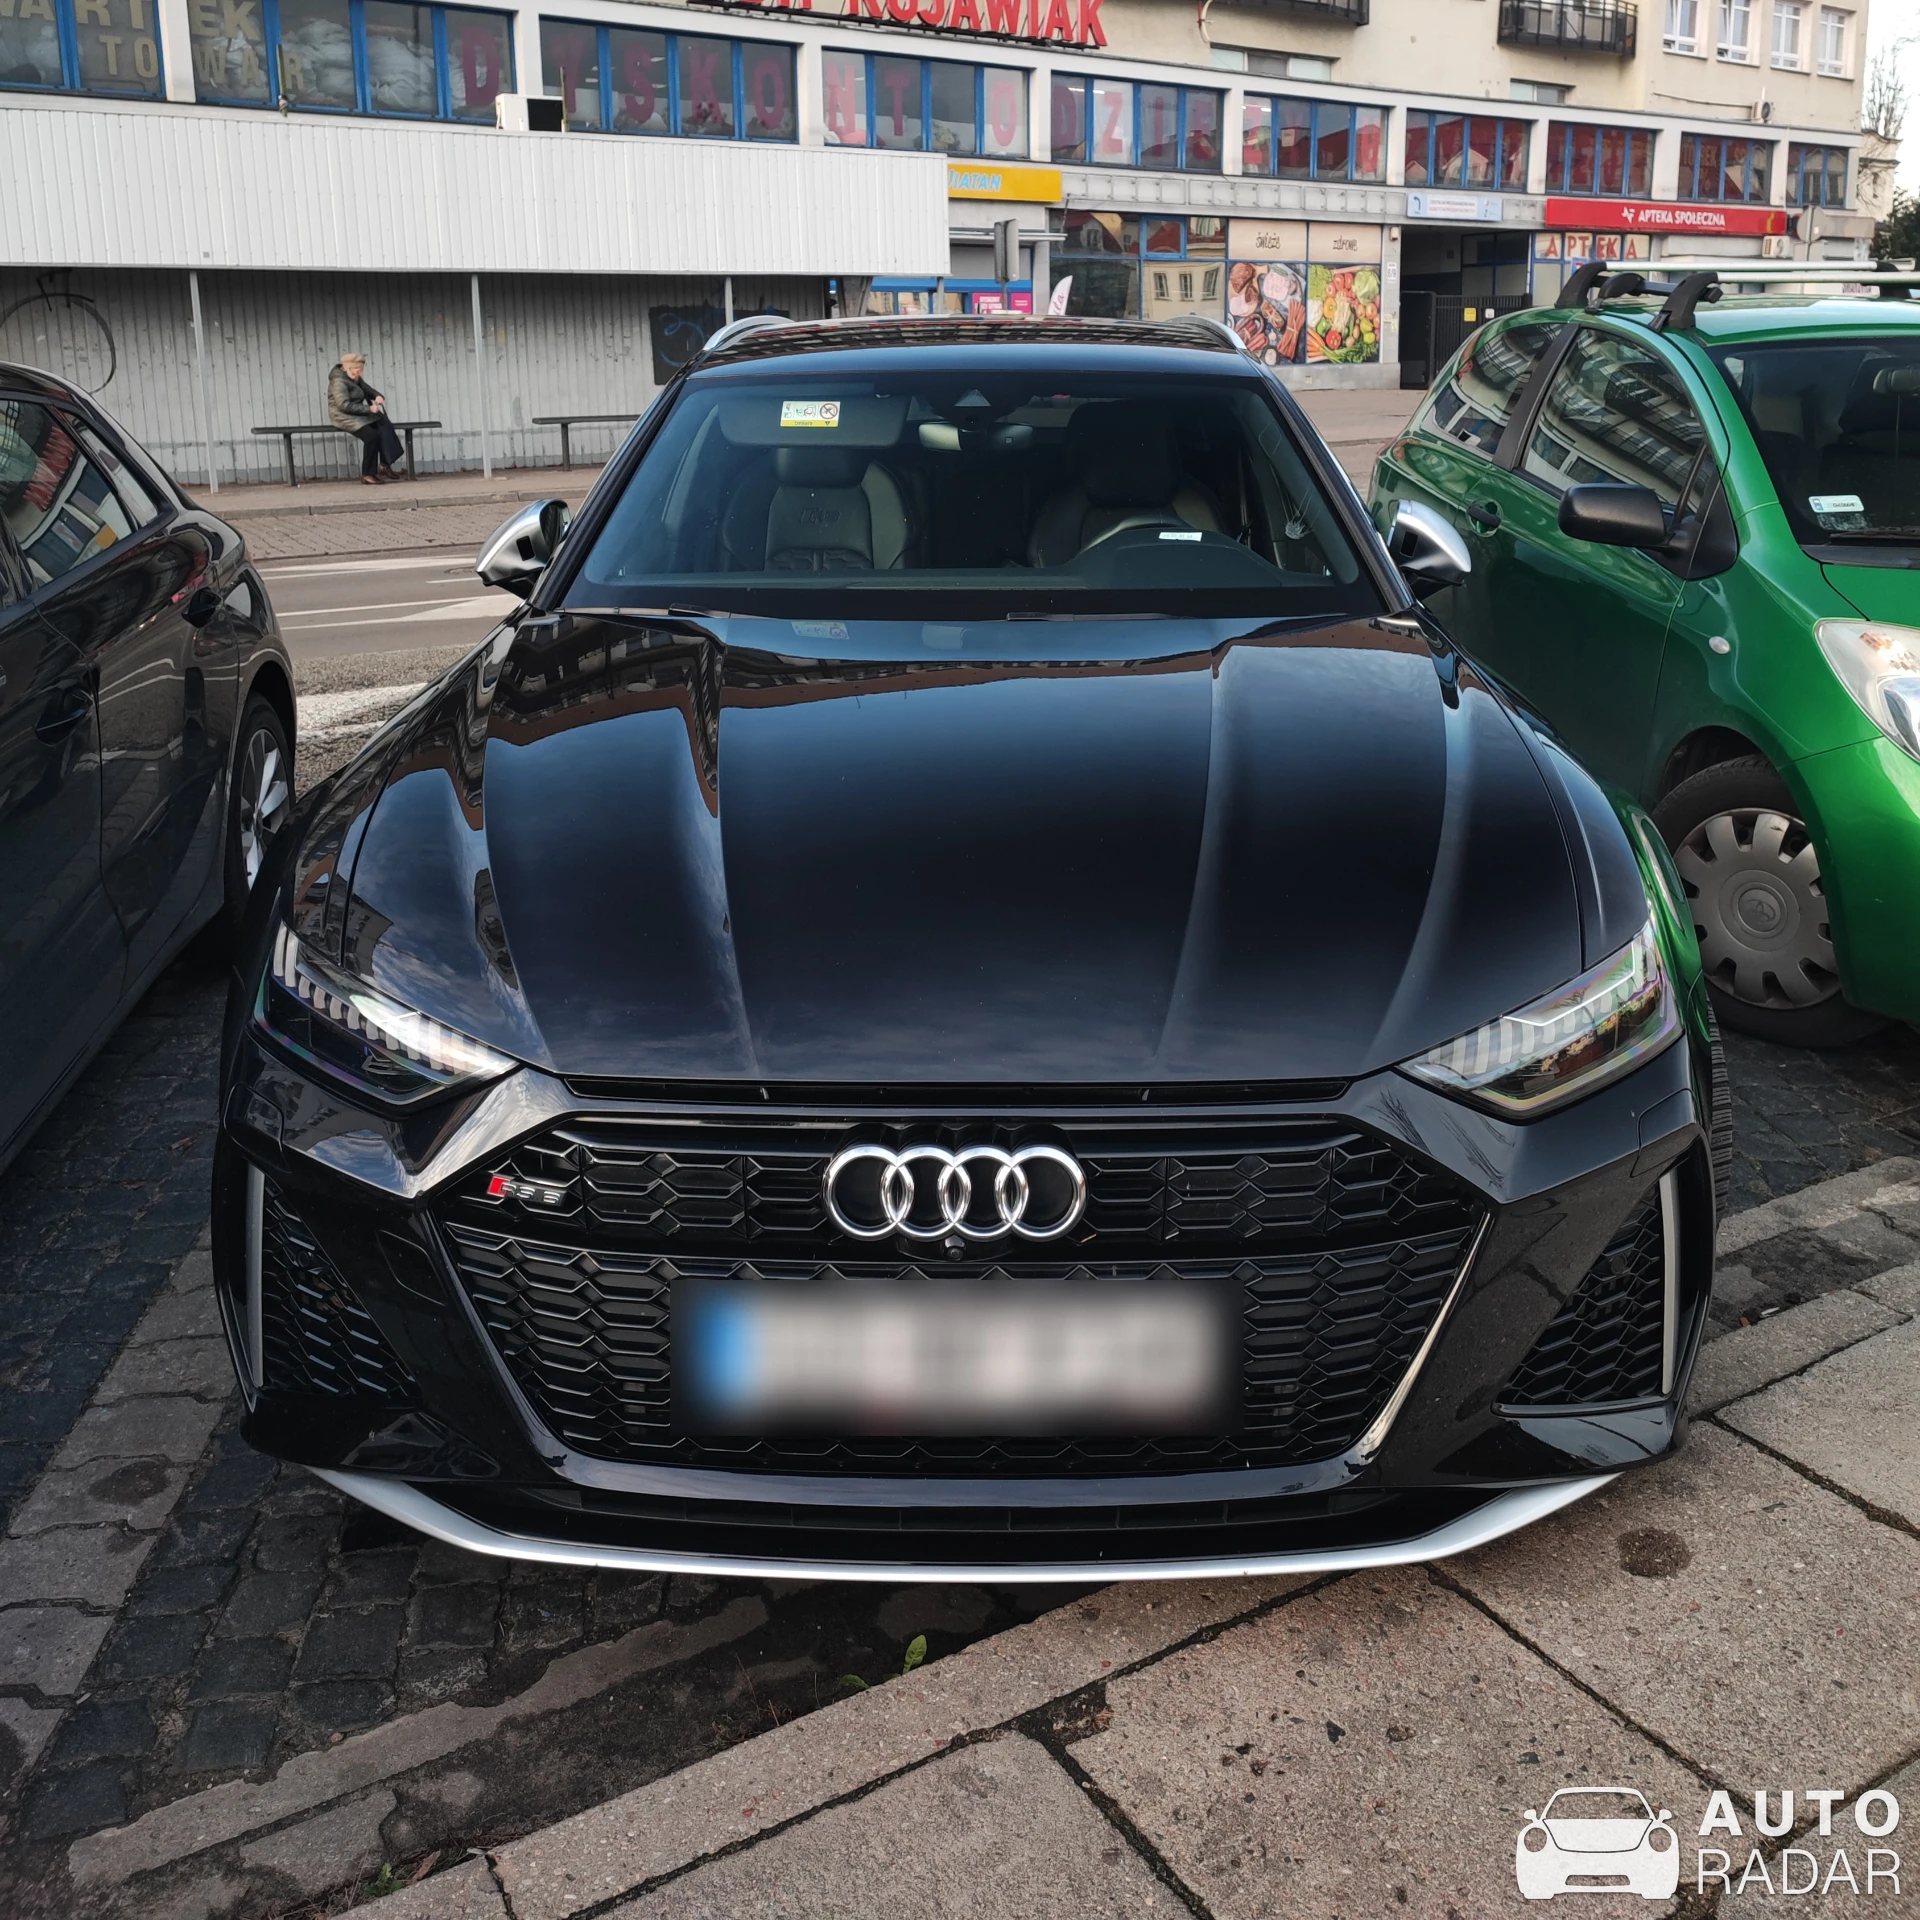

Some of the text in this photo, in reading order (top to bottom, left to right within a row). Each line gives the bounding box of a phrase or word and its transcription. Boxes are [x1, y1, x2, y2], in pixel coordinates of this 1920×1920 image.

[1637, 208, 1726, 227] APTEKA SPOŁECZNA
[1545, 235, 1637, 259] APTEKA
